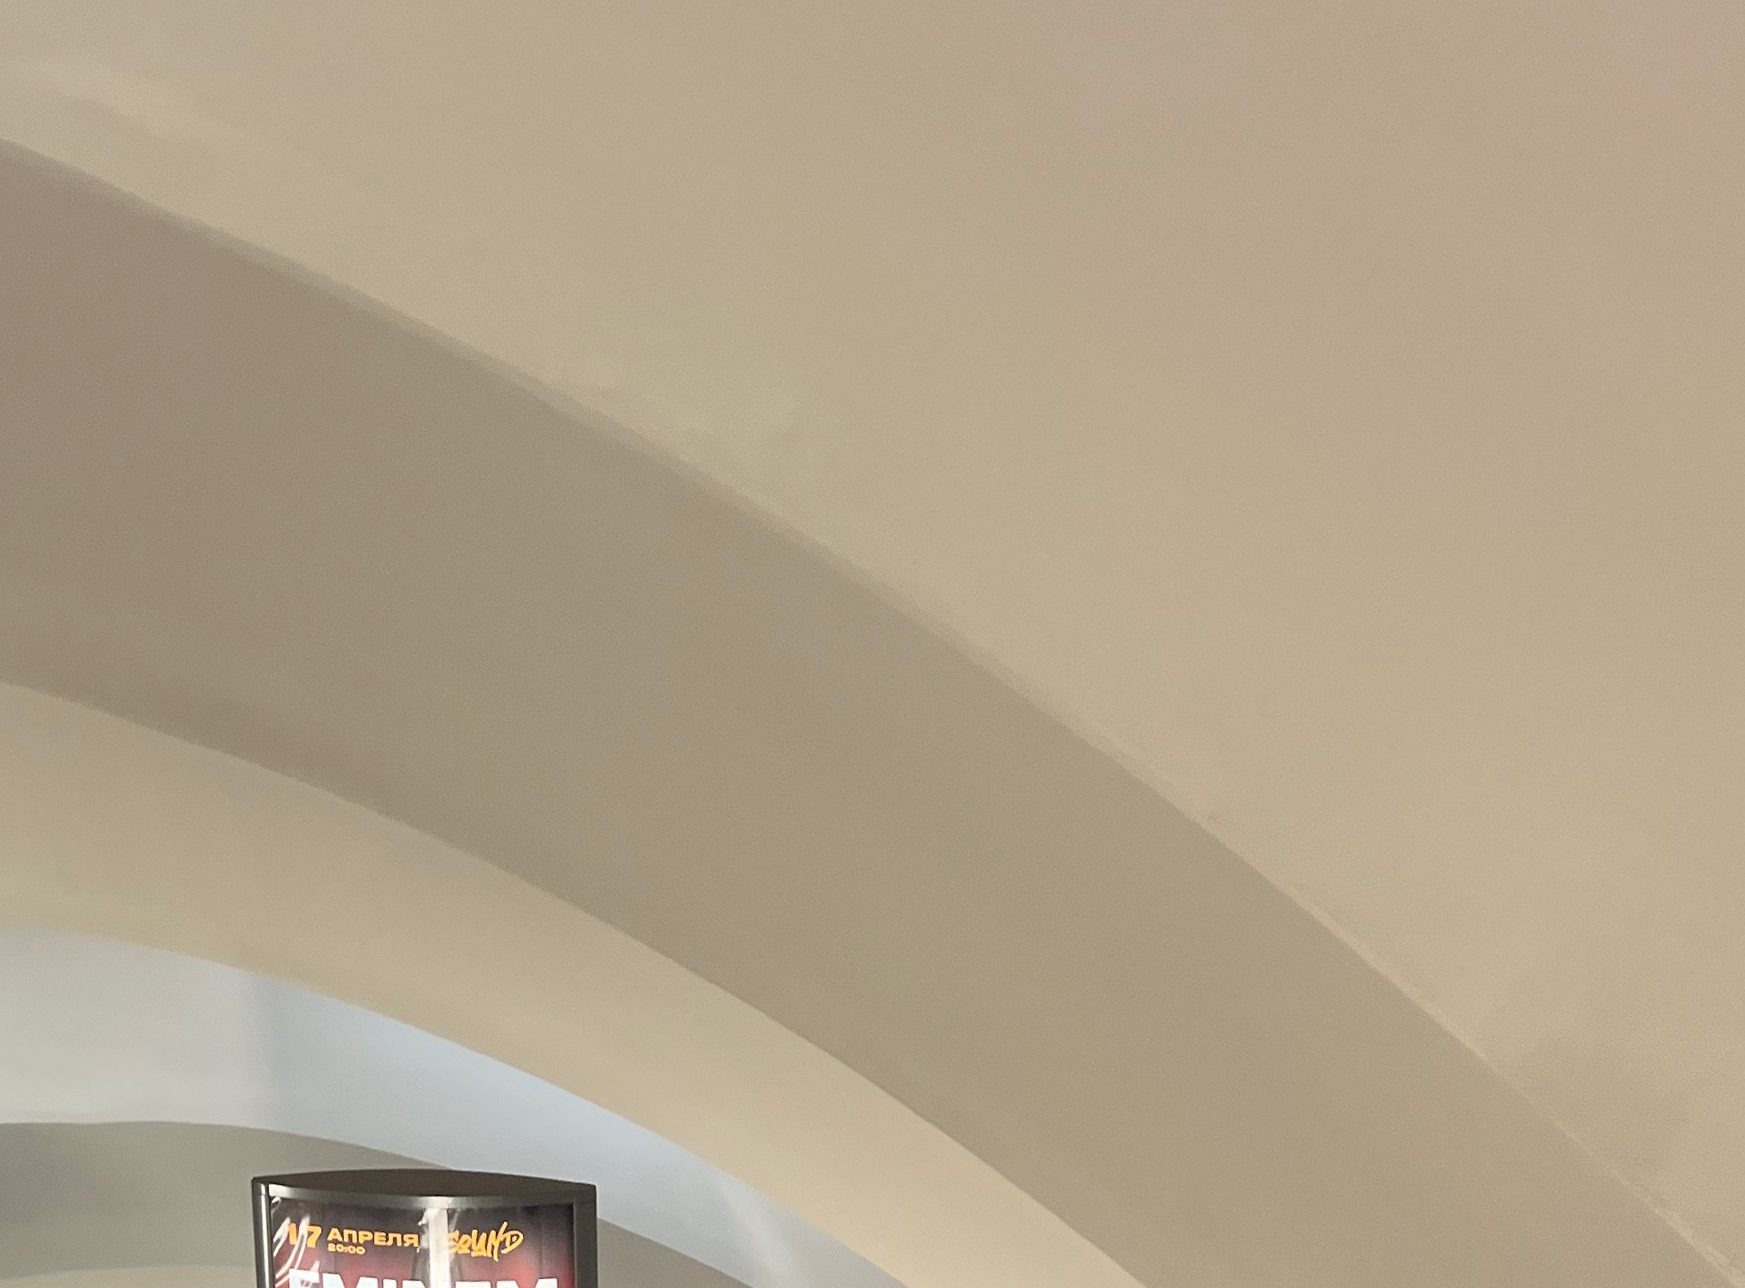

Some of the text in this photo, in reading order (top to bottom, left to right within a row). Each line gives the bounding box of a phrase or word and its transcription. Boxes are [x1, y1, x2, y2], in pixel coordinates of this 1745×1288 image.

[288, 1222, 419, 1248] 17 АПРЕЛЯ
[447, 1221, 524, 1262] SOUND
[327, 1242, 366, 1255] 20:00
